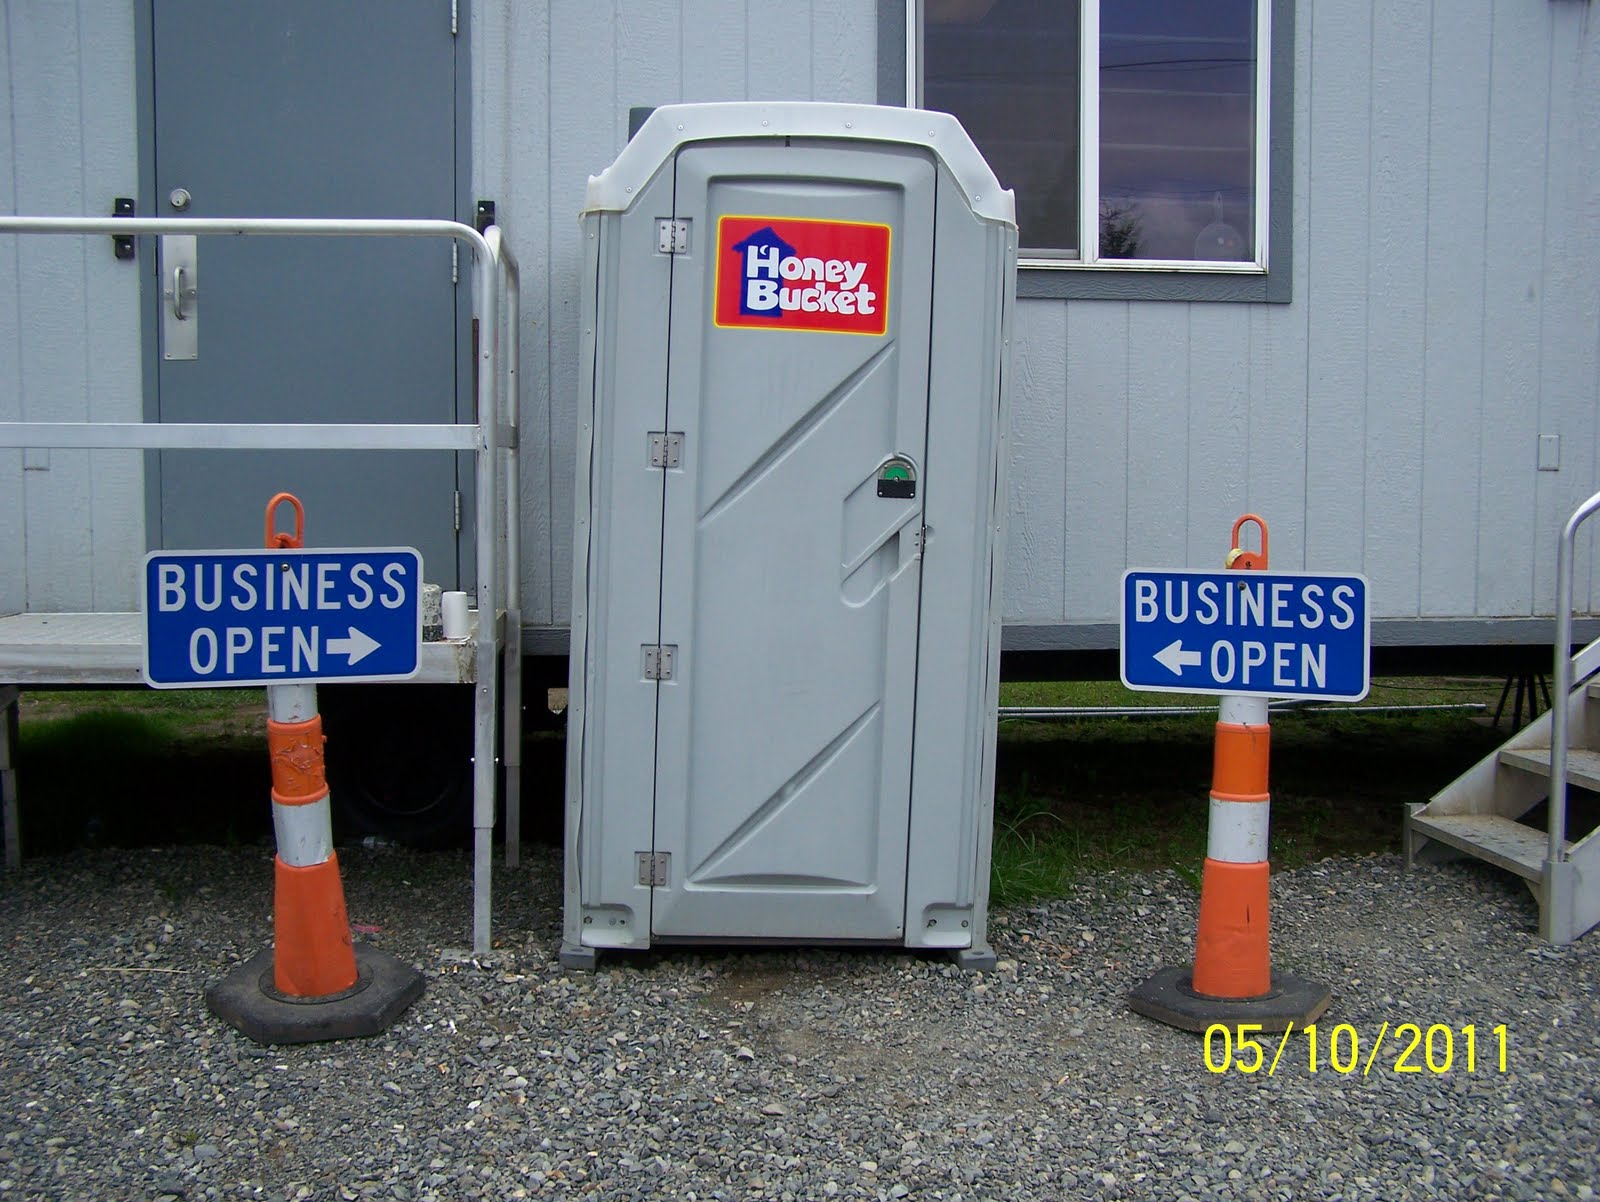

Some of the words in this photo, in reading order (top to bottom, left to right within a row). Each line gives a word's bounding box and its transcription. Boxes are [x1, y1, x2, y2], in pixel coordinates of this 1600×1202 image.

[746, 245, 867, 290] Honey
[746, 279, 876, 315] Bucket
[158, 562, 407, 612] BUSINESS
[1135, 579, 1355, 630] BUSINESS
[189, 626, 319, 675] OPEN
[1210, 639, 1326, 689] OPEN
